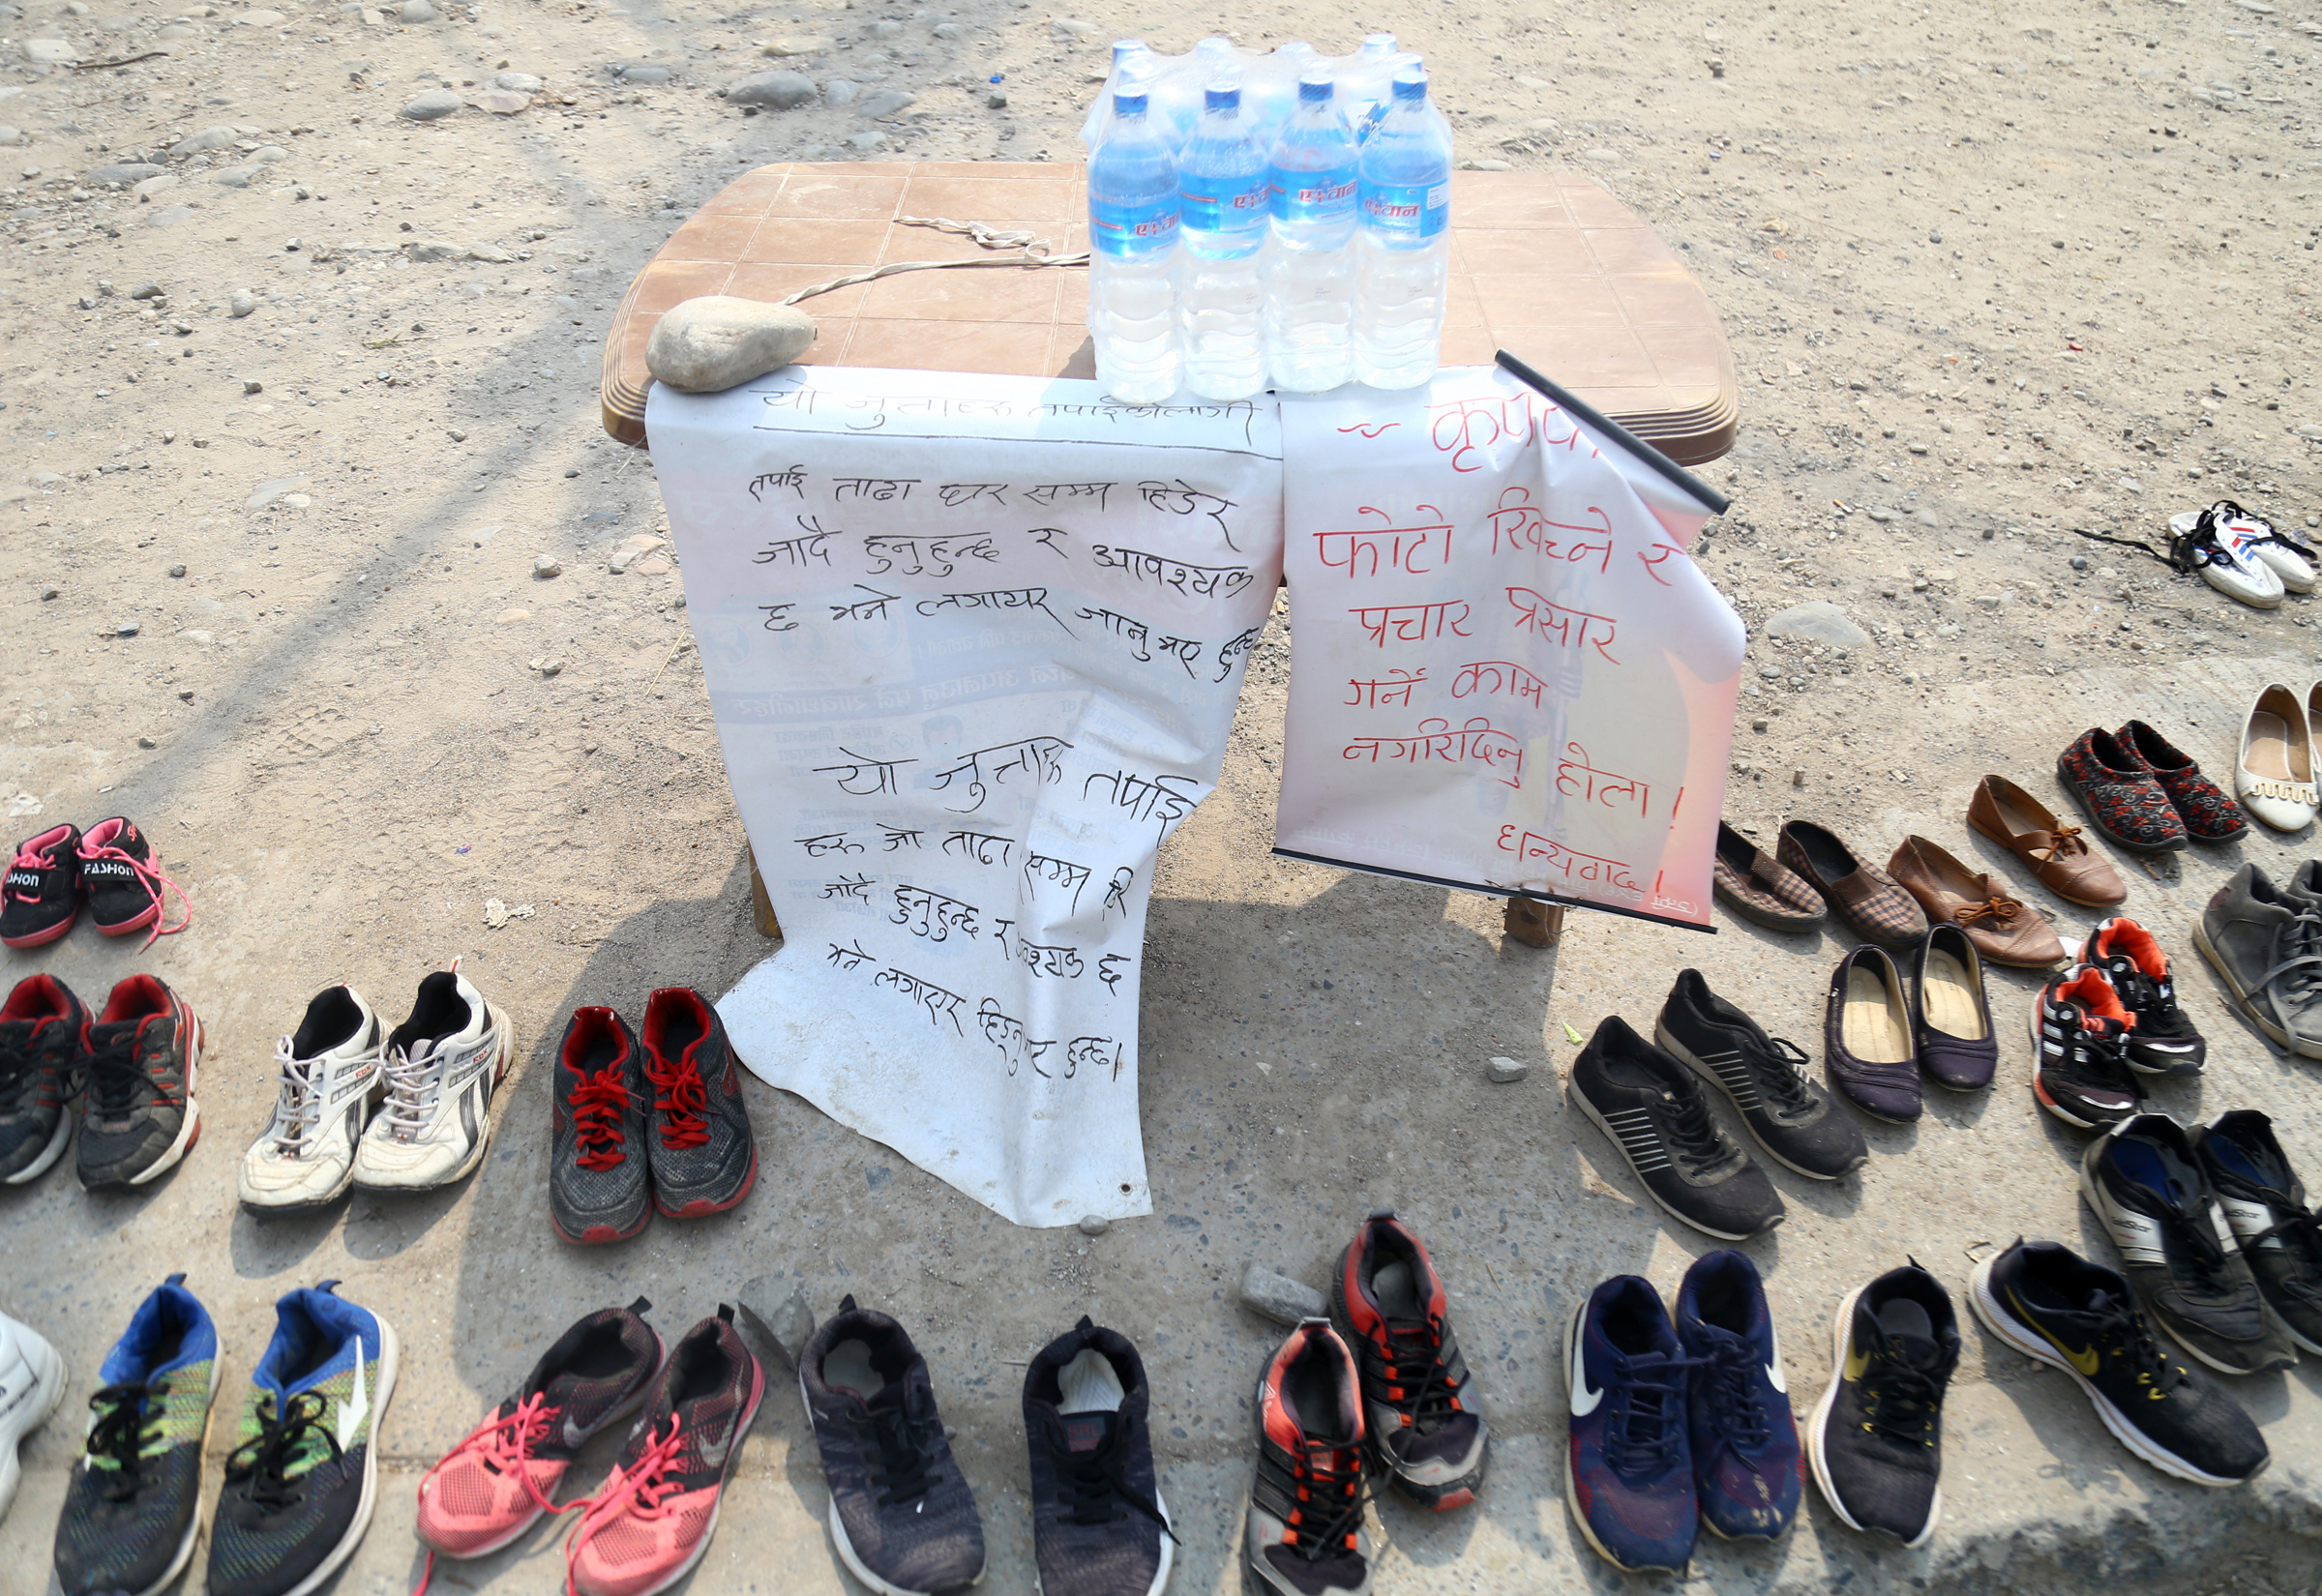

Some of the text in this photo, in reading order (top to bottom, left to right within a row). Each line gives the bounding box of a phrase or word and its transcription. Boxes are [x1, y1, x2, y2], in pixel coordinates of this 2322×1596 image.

[1424, 392, 1599, 472] कृपय
[1027, 528, 1068, 559] र
[1313, 505, 1455, 578] फोटो
[1637, 542, 1685, 586] र
[1349, 600, 1473, 648] प्रचार
[1452, 661, 1548, 709] काम
[994, 918, 1016, 961] र
